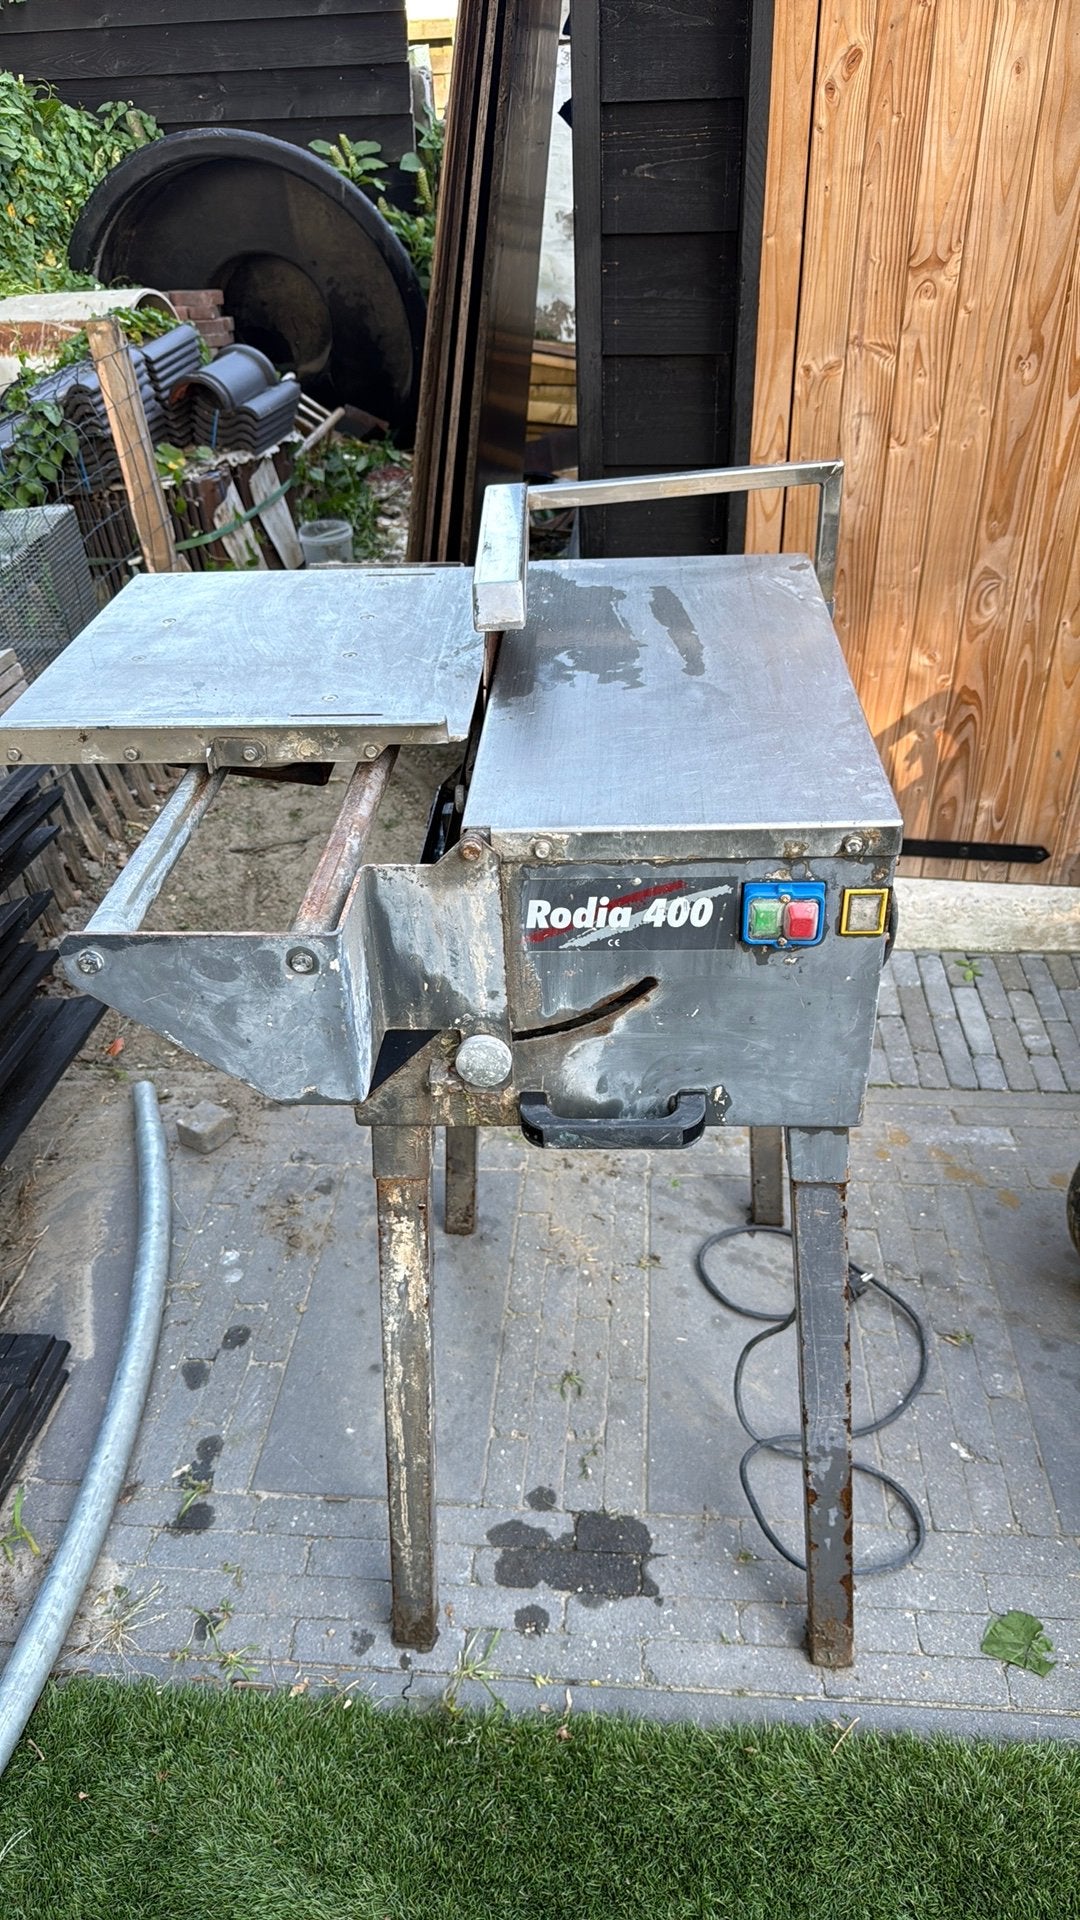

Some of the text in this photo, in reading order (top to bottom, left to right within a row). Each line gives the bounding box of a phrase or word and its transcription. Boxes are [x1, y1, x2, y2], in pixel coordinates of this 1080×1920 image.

[526, 896, 713, 929] Rodia 400
[607, 938, 620, 947] CE
